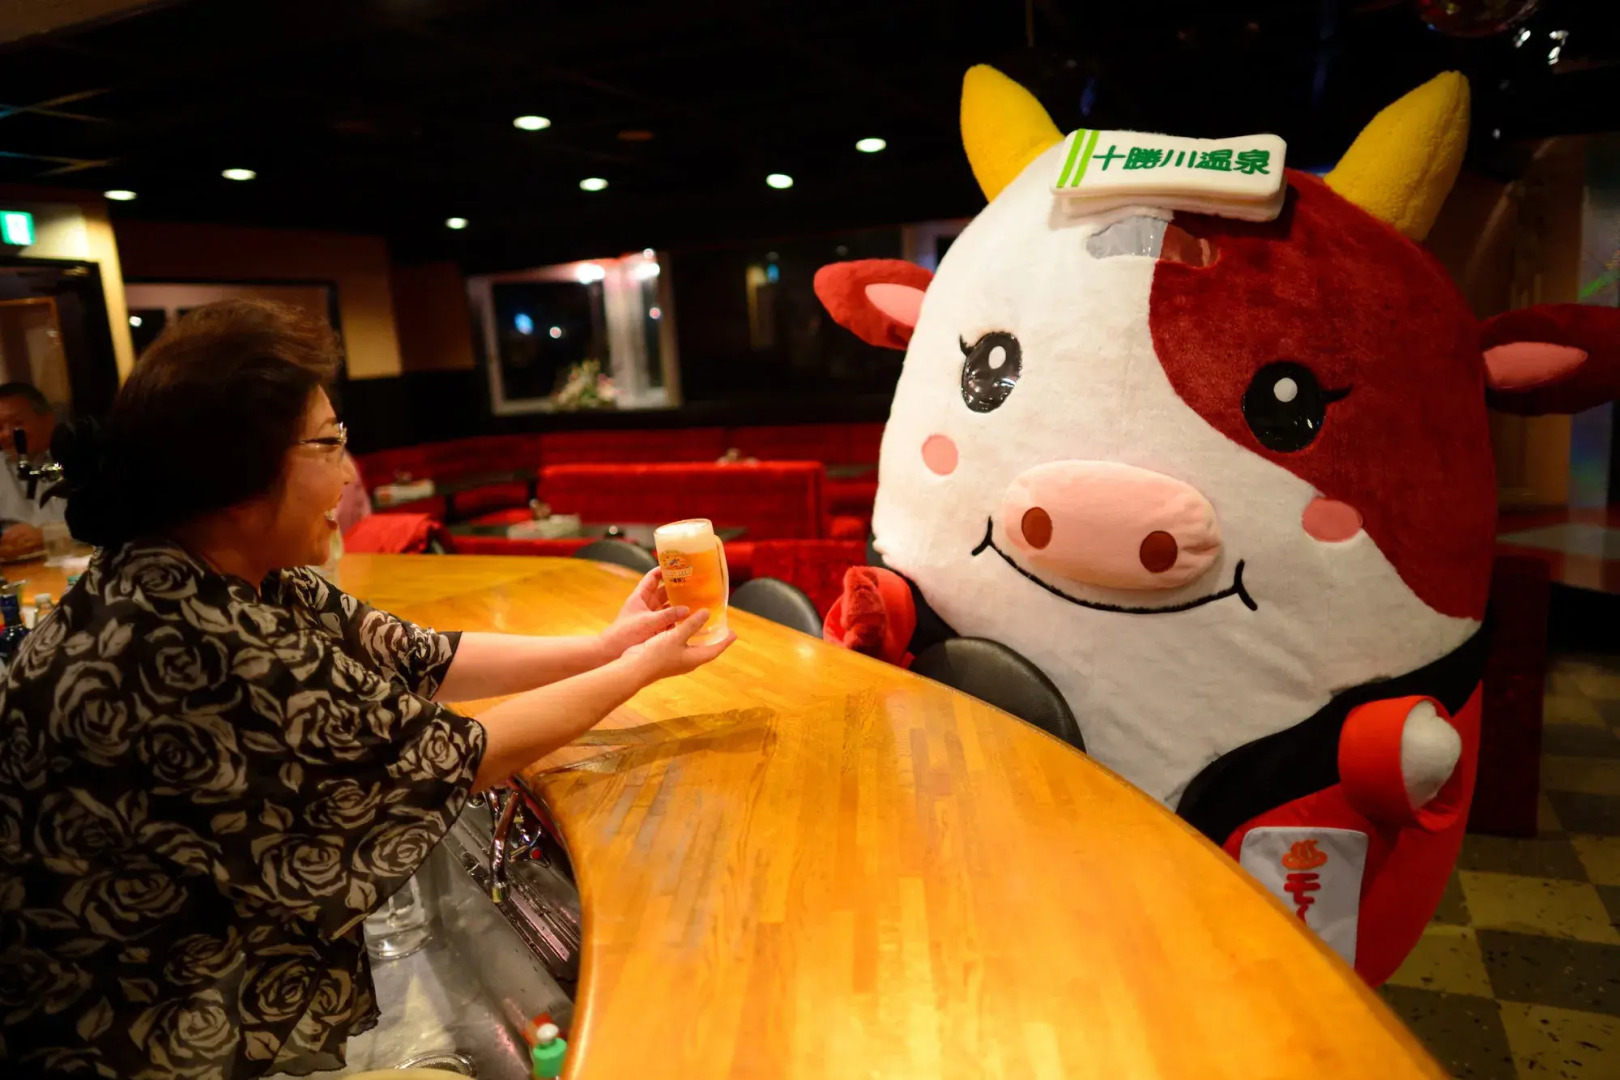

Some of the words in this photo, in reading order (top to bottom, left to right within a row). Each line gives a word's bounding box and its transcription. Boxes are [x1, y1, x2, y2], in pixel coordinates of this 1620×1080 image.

[1092, 145, 1270, 175] 十勝川温泉
